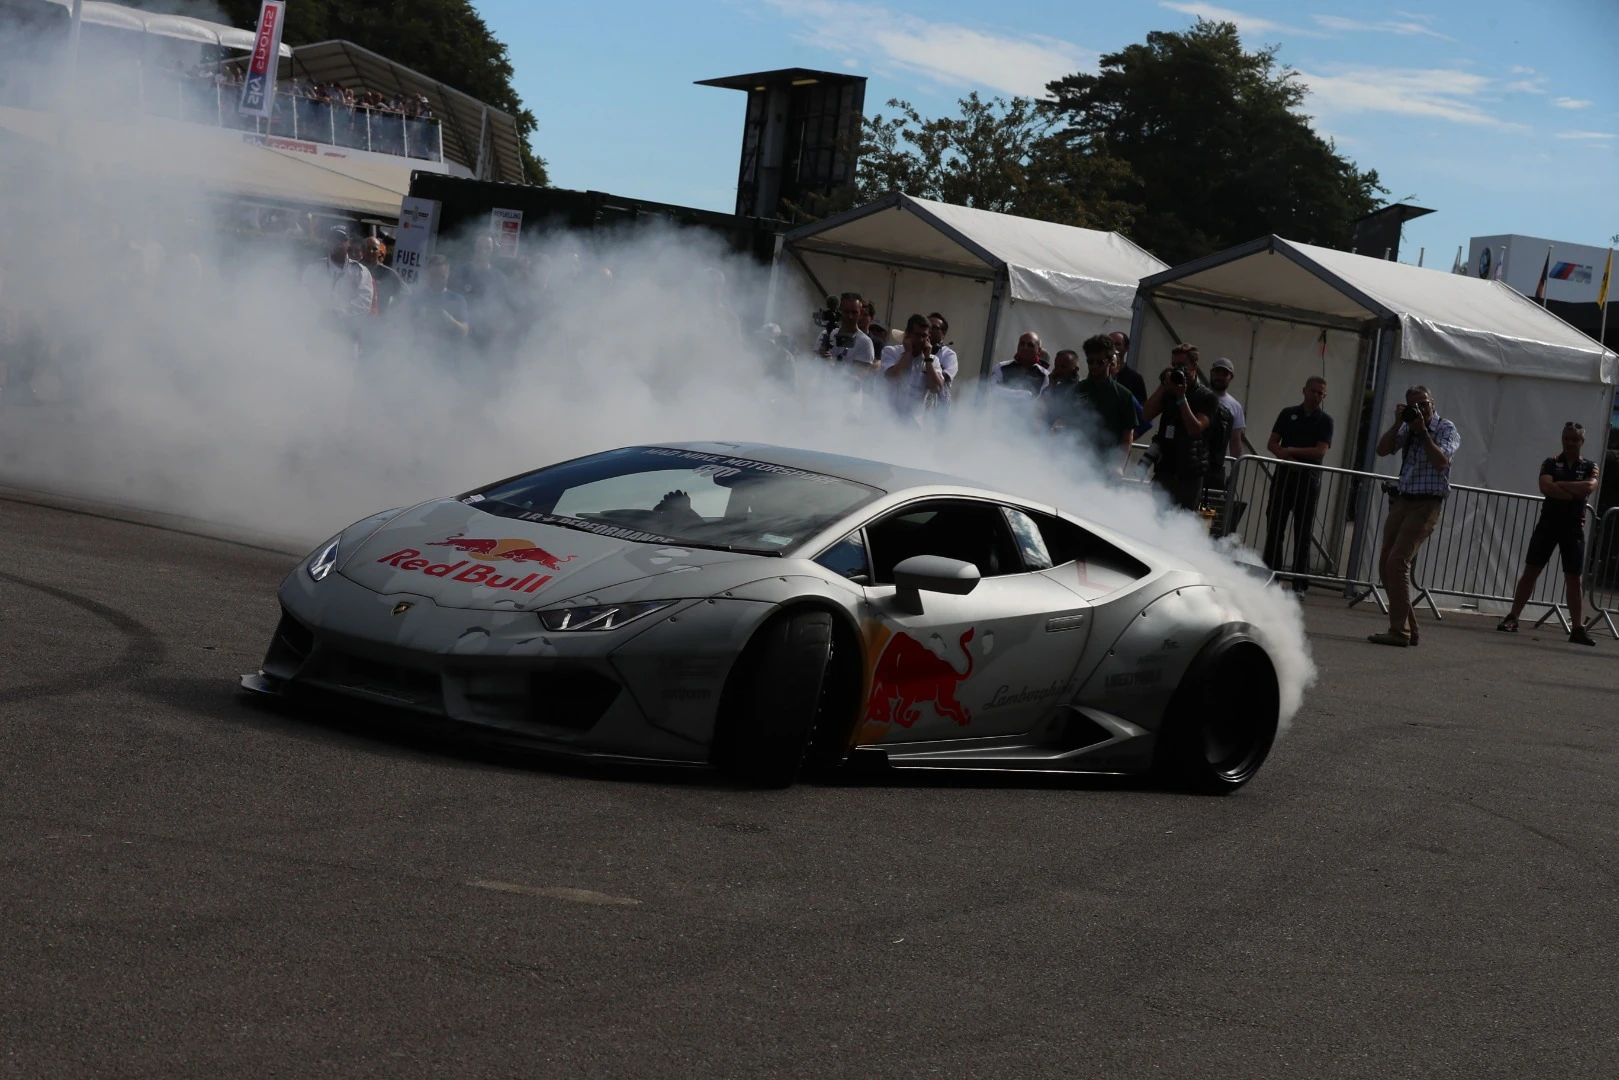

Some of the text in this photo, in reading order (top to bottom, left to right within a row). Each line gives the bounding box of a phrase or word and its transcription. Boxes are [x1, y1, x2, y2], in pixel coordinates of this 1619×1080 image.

[396, 249, 421, 267] FUEL
[722, 458, 842, 485] MOTORSPORT
[377, 548, 553, 593] Red Bull
[981, 678, 1077, 710] Lamborghini
